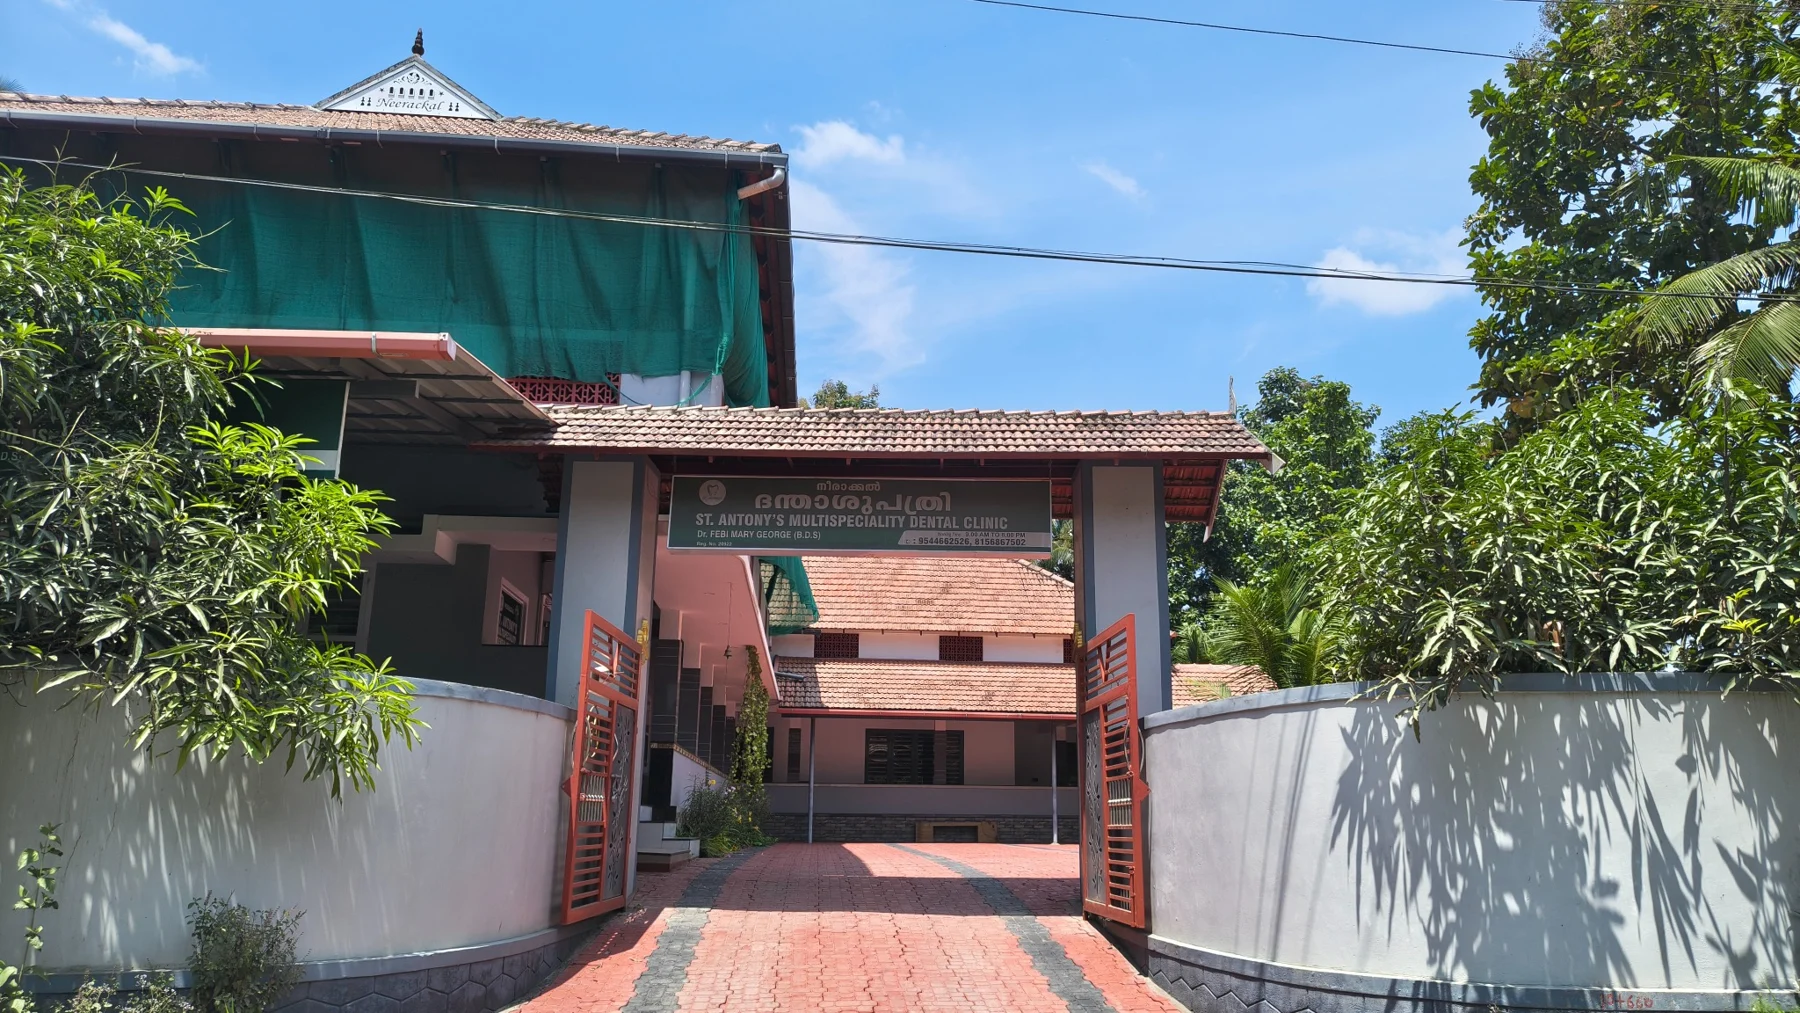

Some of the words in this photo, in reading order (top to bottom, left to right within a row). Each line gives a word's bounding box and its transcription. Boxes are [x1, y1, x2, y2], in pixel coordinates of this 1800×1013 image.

[376, 98, 445, 112] Neerackal
[755, 492, 951, 515] ദന്താശുപത്രി
[696, 513, 714, 526] ST.
[718, 513, 785, 527] ANTONY'S
[789, 514, 906, 529] MULTISPECIALITY
[910, 516, 959, 529] DENTAL
[963, 516, 1008, 530] CLINIC
[697, 530, 708, 538] Dr.
[710, 530, 729, 538] FEBI
[731, 531, 754, 539] MARY
[756, 531, 791, 539] GEORGE
[793, 531, 821, 540] (B.D.S)
